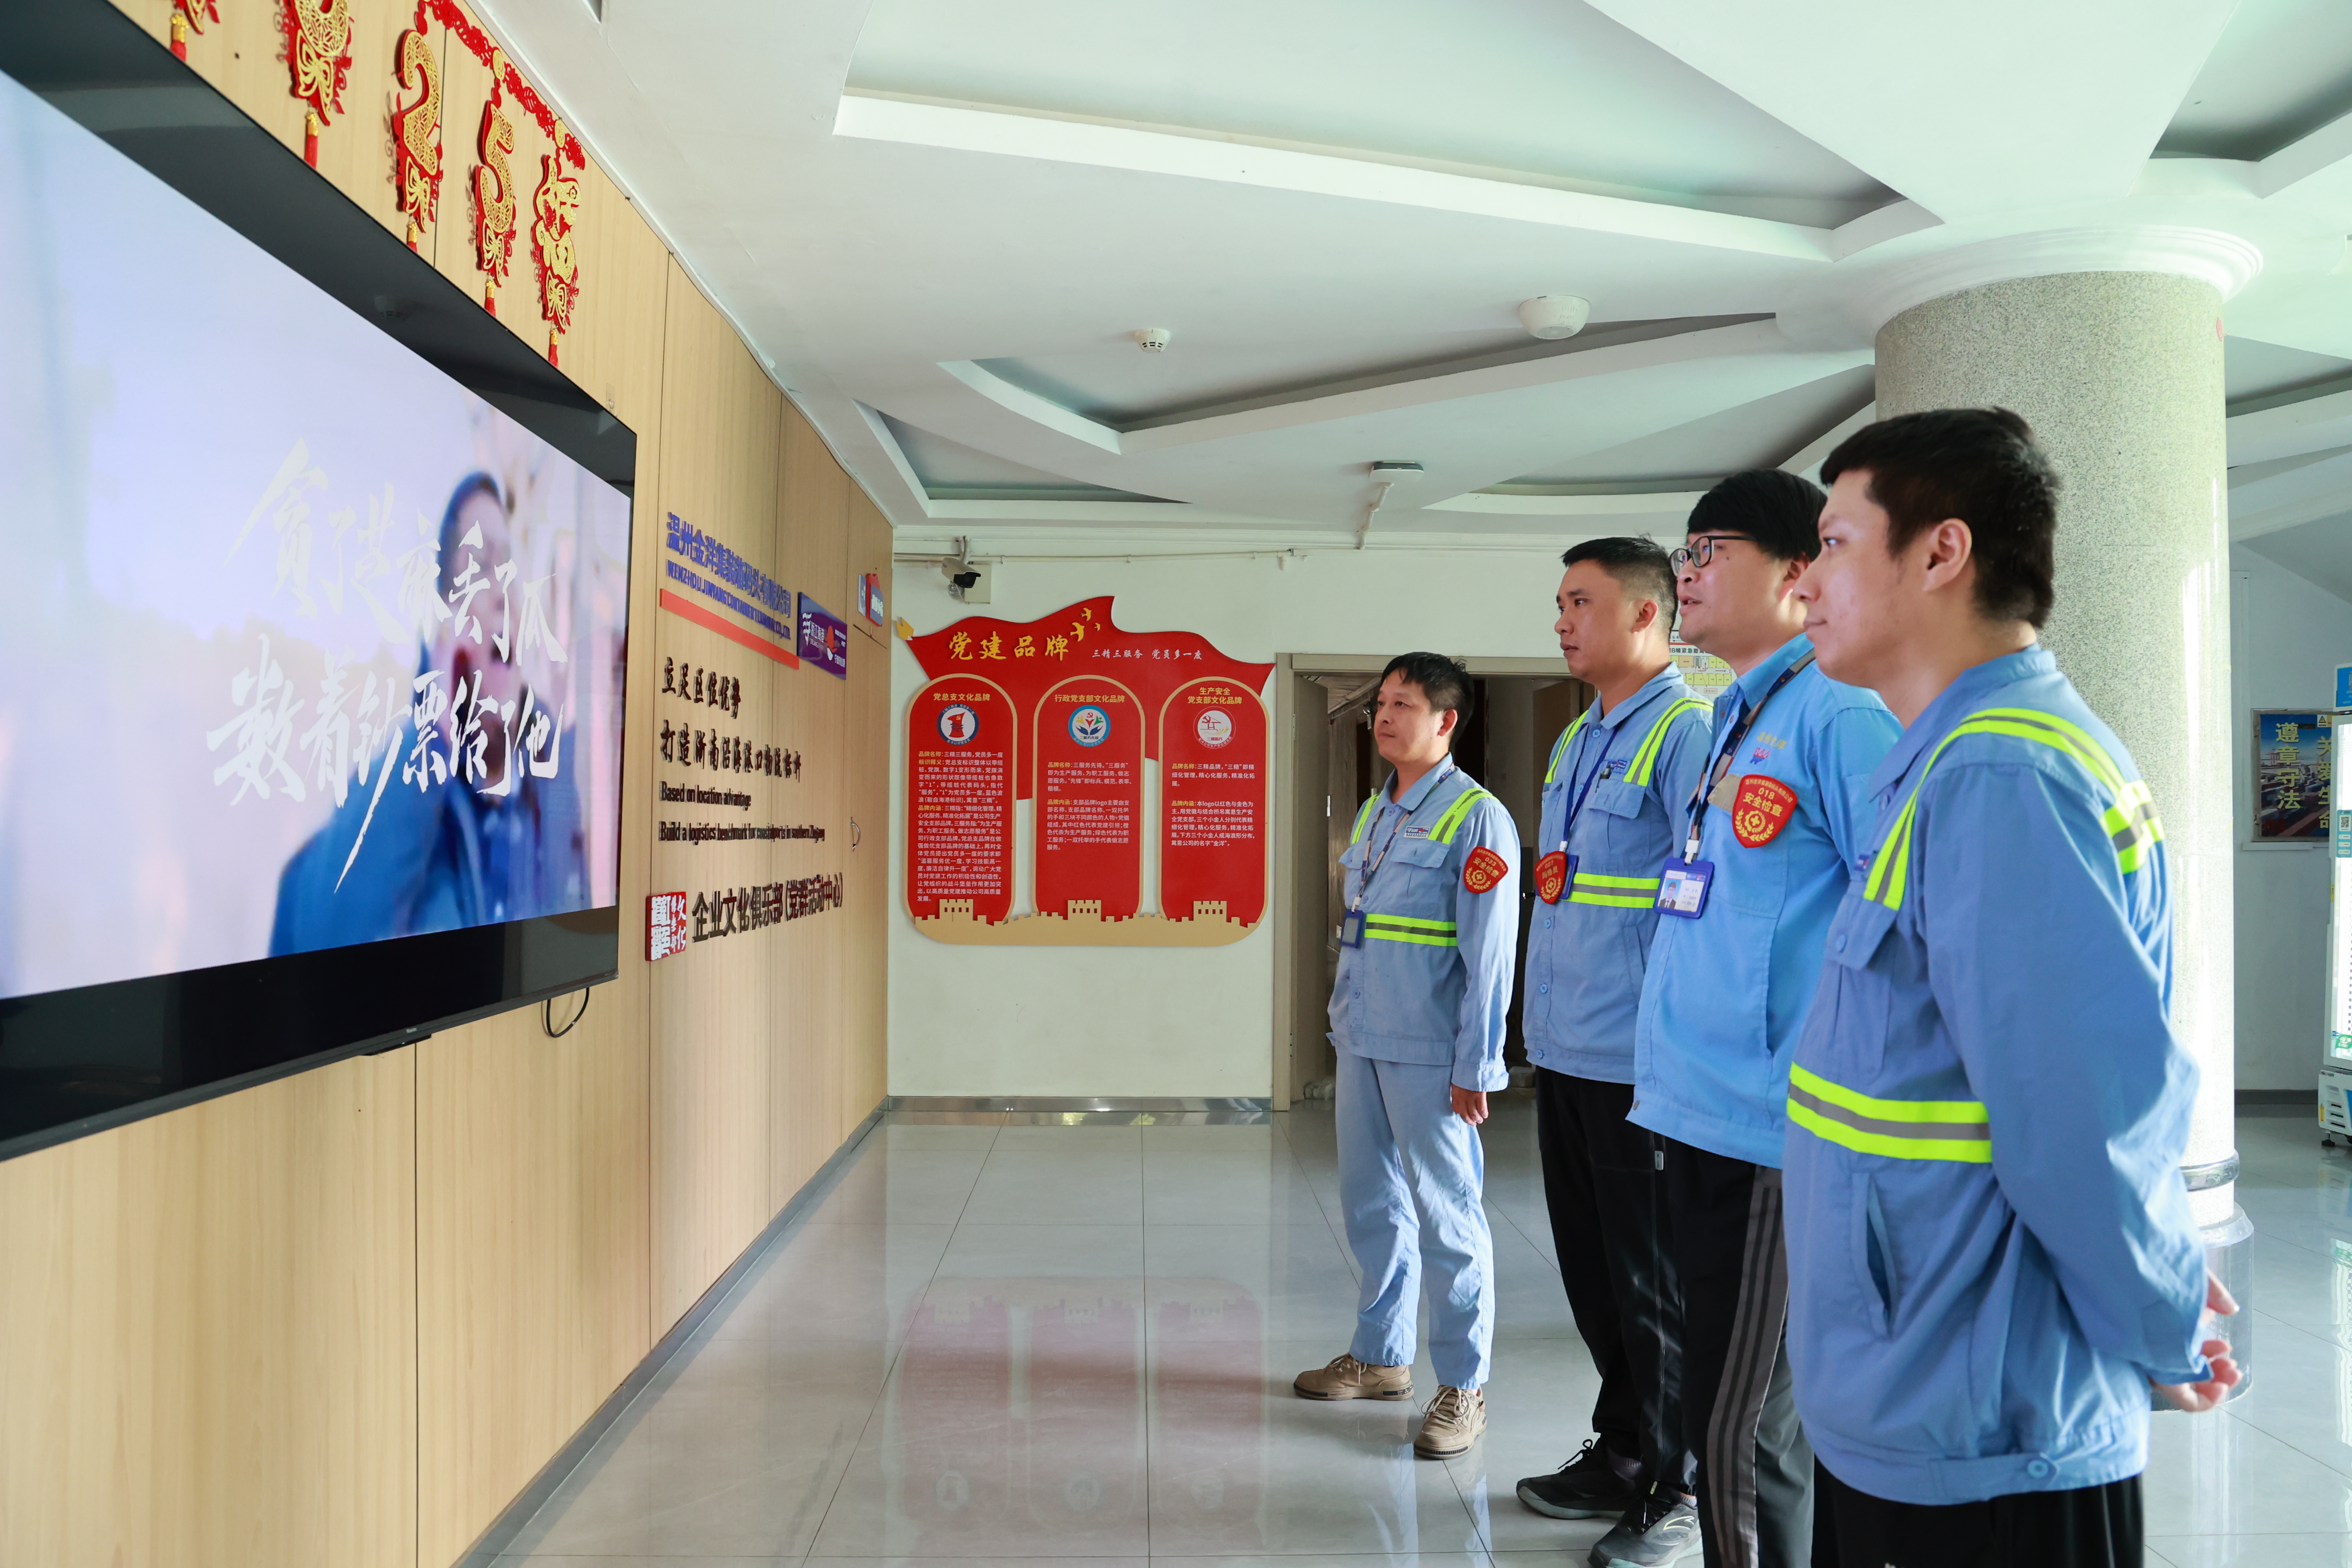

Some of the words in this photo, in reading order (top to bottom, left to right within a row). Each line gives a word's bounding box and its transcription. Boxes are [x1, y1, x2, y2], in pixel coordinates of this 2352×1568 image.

[665, 560, 701, 591] WENZHOU
[667, 511, 791, 618] 温州金洋集装箱码头有限公司
[949, 631, 1069, 662] 党建品牌
[1092, 649, 1143, 659] 三精三服务
[1151, 649, 1203, 661] 党员多一度
[662, 656, 741, 720] 立足区位优势
[933, 692, 991, 701] 党总支文化品牌
[1054, 694, 1125, 703] 行政党支部文化品牌
[1199, 687, 1231, 695] 生产安全
[1188, 696, 1243, 705] 党支部文化品牌
[660, 719, 801, 783] 打造浙南沿海港口物流标杆
[206, 634, 564, 894] 数着钞票给了他
[2275, 722, 2301, 810] 遵章守法
[659, 781, 685, 802] Based
[685, 788, 695, 802] on
[695, 784, 722, 805] location
[722, 787, 751, 811] advantage
[1743, 792, 1783, 817] 安全检查
[1758, 787, 1775, 800] 018
[658, 821, 680, 841] Build
[680, 827, 687, 841] a
[687, 822, 716, 845] logistics
[716, 823, 747, 841] benchmark
[747, 823, 756, 840] for
[1473, 857, 1500, 878] 安全检查
[1485, 857, 1497, 867] 033
[1544, 860, 1554, 869] 007
